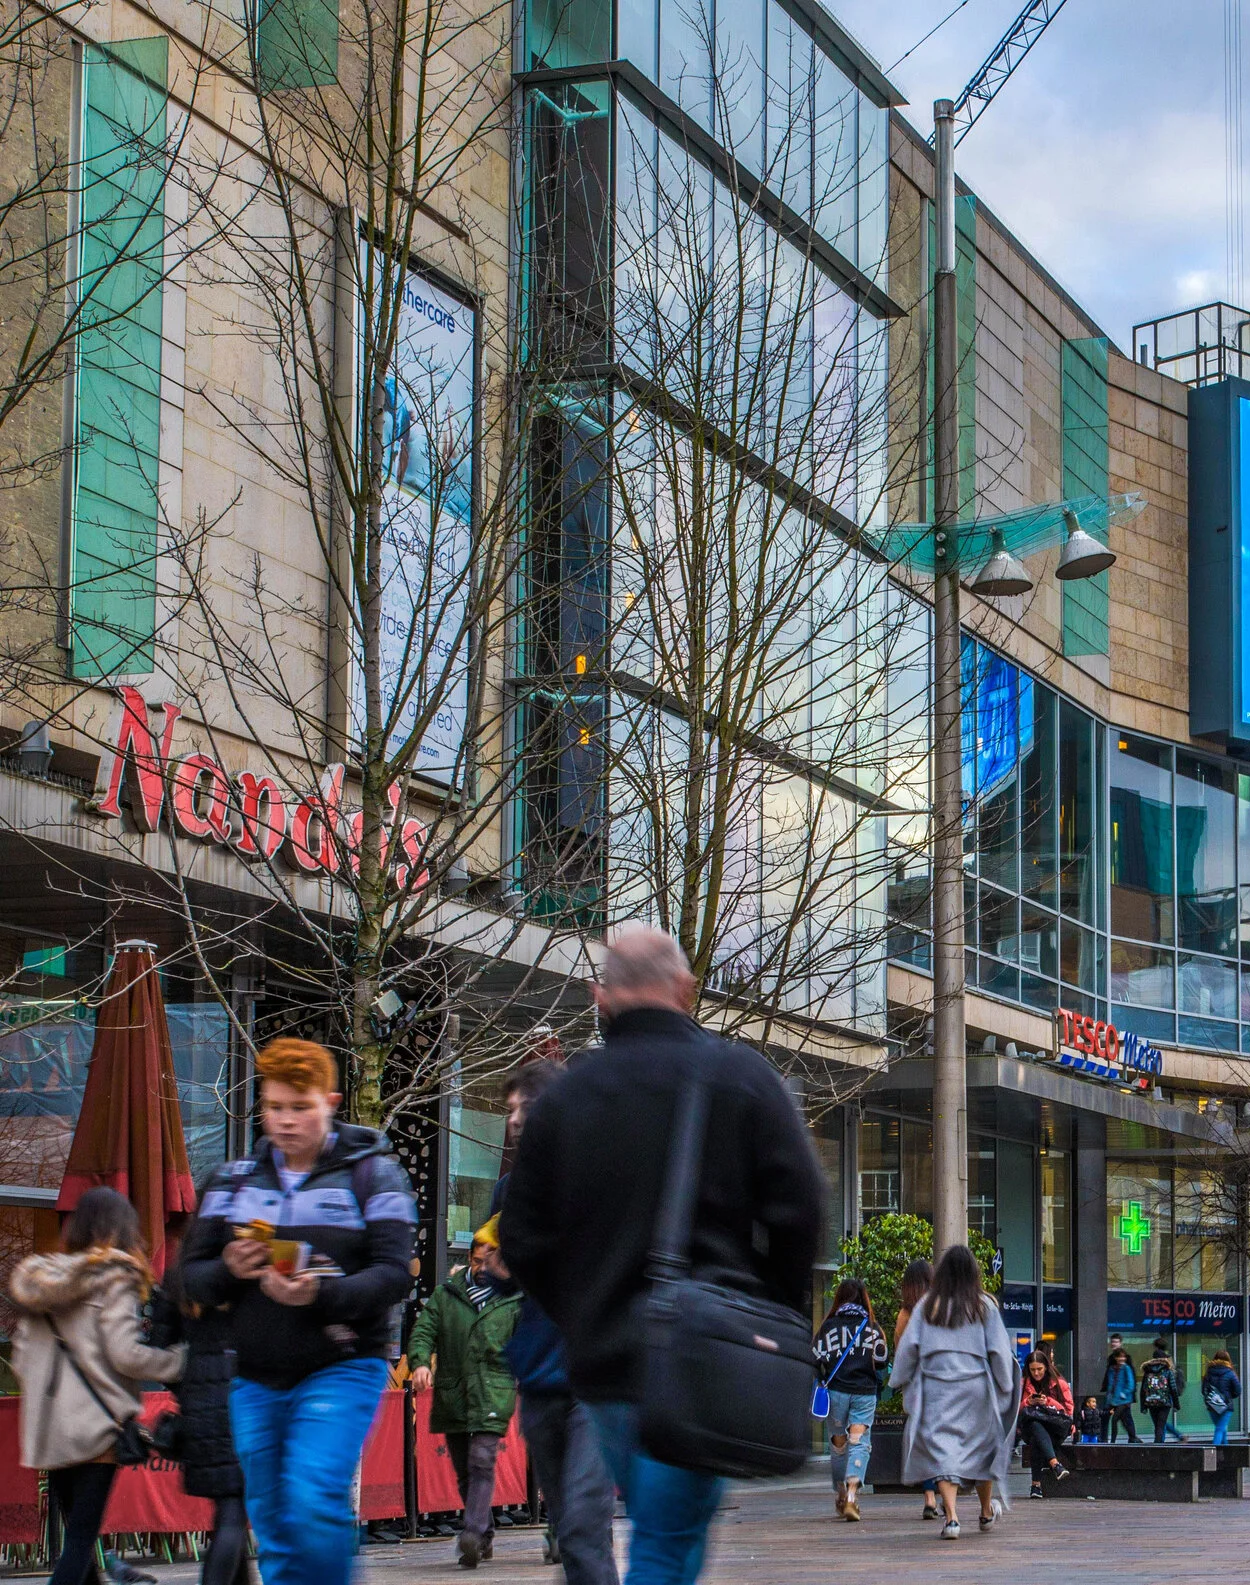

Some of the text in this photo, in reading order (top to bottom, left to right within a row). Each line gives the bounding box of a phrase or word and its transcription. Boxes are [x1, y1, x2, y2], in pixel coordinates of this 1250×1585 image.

[1058, 1008, 1163, 1076] TESCO Metro
[1141, 1299, 1236, 1319] TESCO Metro
